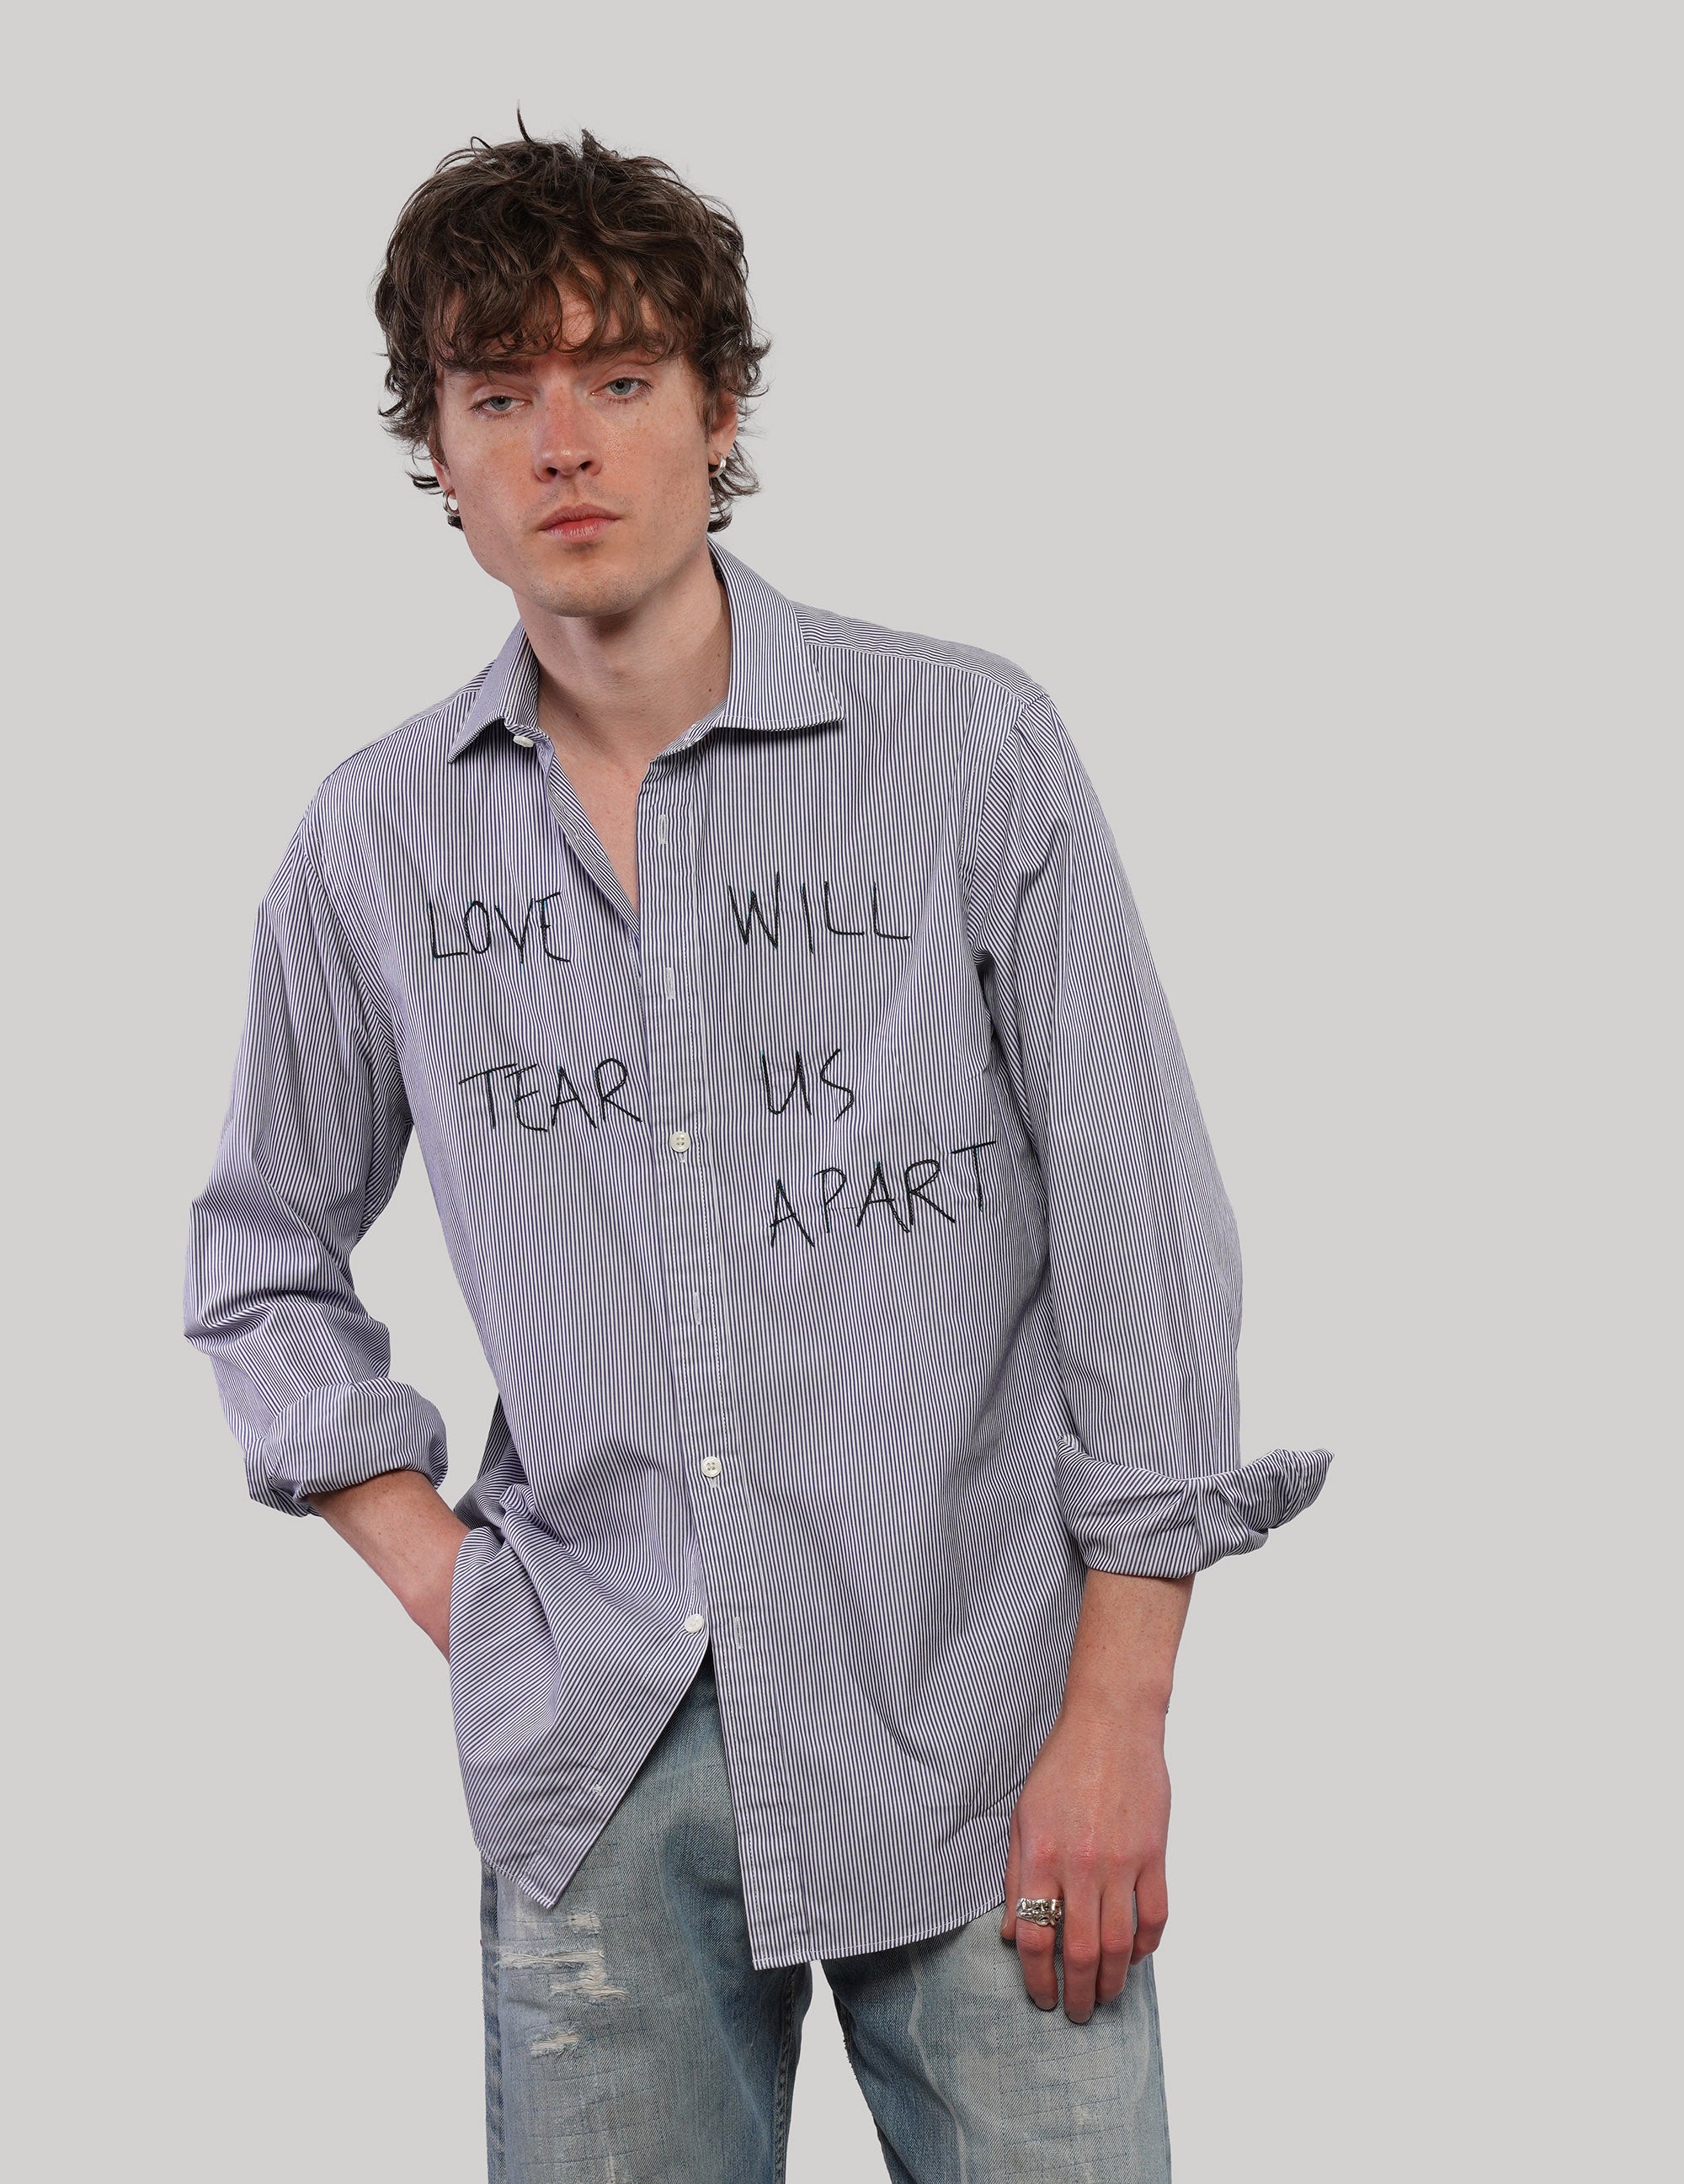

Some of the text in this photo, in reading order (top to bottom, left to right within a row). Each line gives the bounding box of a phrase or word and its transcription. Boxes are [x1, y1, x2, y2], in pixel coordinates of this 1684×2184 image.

[427, 871, 911, 965] LOVE WILL
[458, 1047, 855, 1132] TEAR US
[769, 1140, 997, 1248] APART
